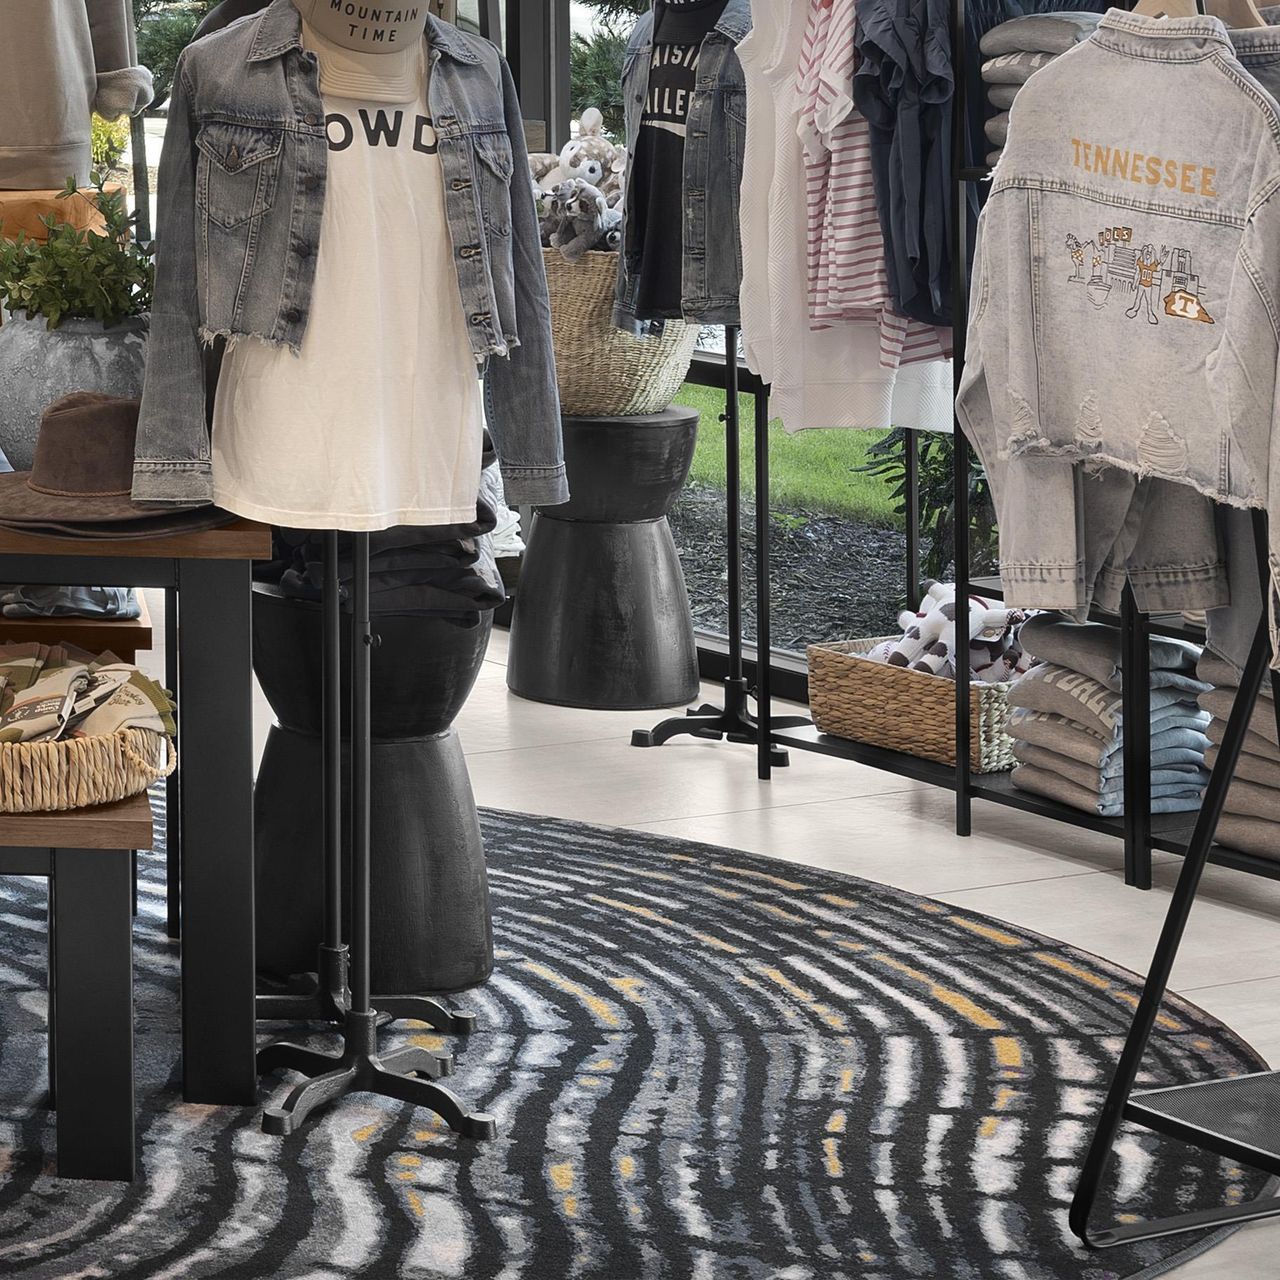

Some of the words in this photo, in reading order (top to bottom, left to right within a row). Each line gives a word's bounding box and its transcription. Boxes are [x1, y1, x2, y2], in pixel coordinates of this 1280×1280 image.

[348, 23, 397, 43] TIME
[1071, 138, 1217, 197] TENNESSEE
[1178, 294, 1195, 313] T
